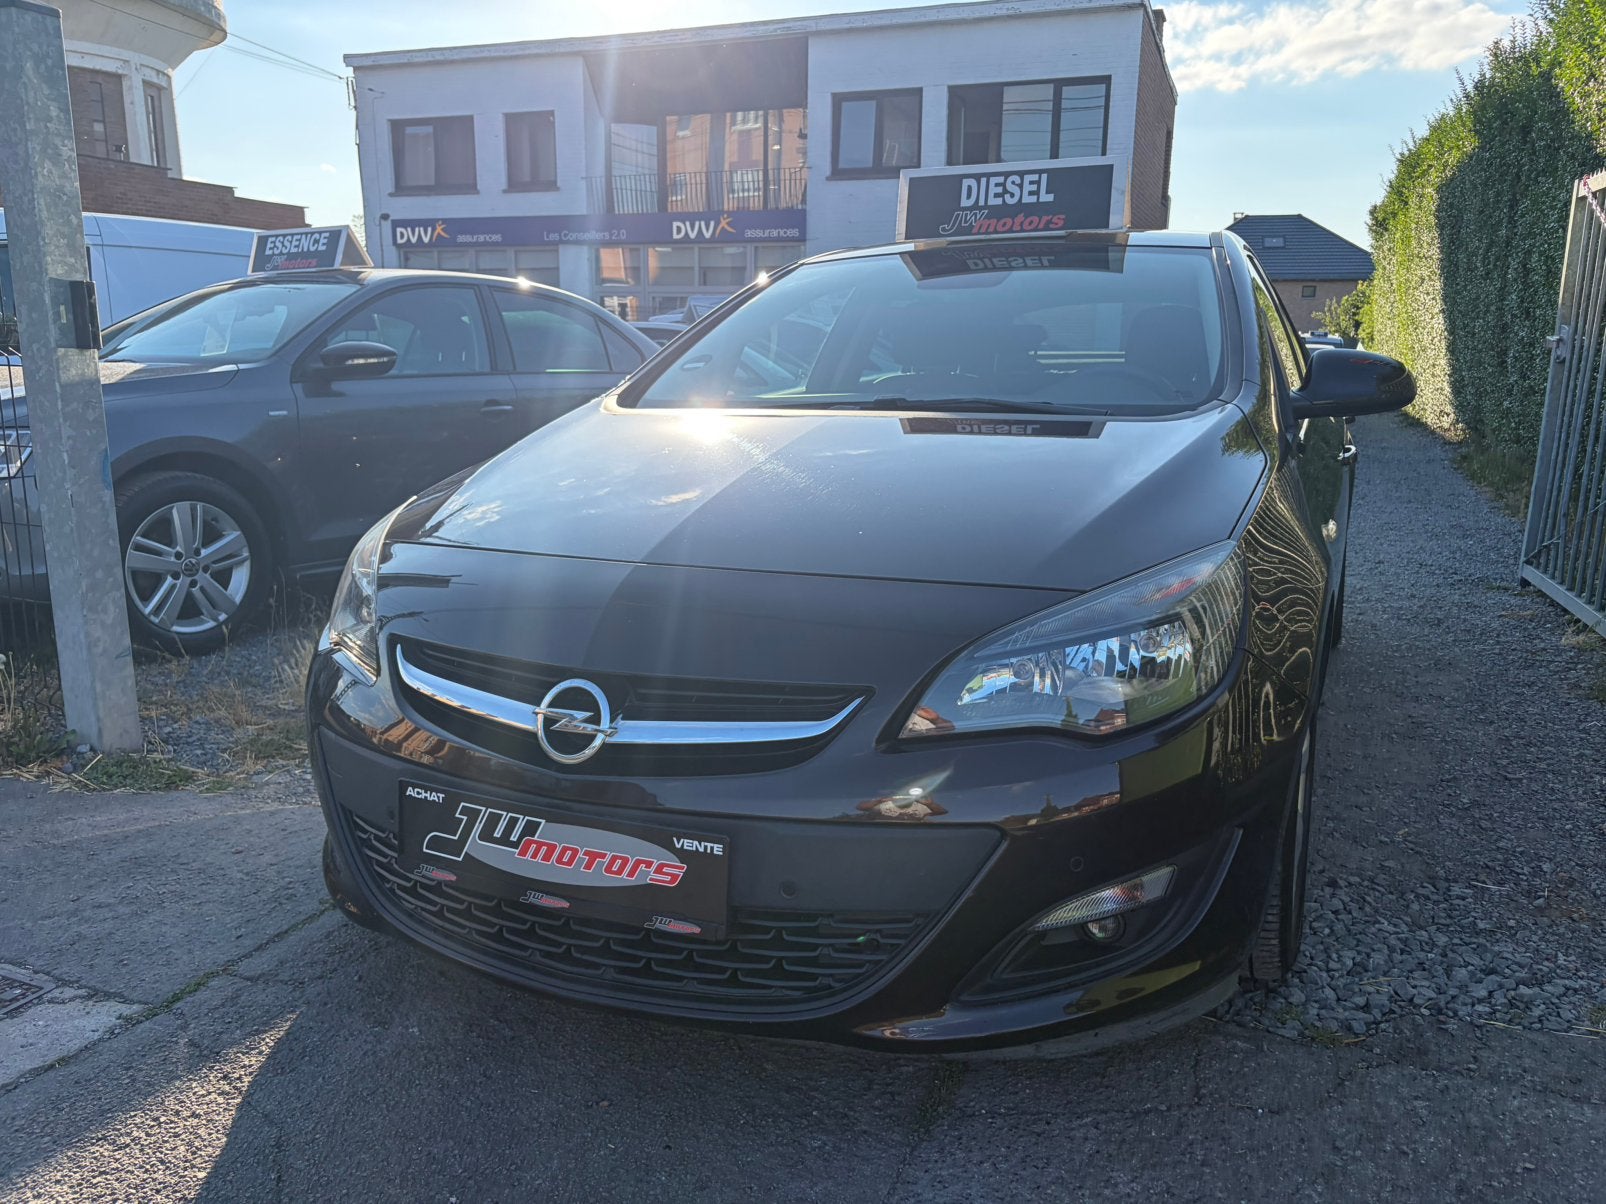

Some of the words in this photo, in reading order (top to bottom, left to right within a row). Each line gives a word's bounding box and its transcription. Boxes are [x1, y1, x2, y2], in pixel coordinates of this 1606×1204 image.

[960, 173, 1055, 208] DIESEL
[672, 220, 715, 239] DVV
[744, 227, 800, 238] assurances
[939, 210, 988, 234] JW
[972, 212, 1066, 234] motors
[265, 232, 330, 256] ESSENCE
[396, 226, 432, 244] DVV
[456, 233, 503, 243] assurances
[543, 231, 560, 241] Les
[611, 229, 627, 240] 2.0
[405, 785, 445, 803] ACHAT
[423, 802, 545, 861] JW
[673, 837, 723, 855] VENTE
